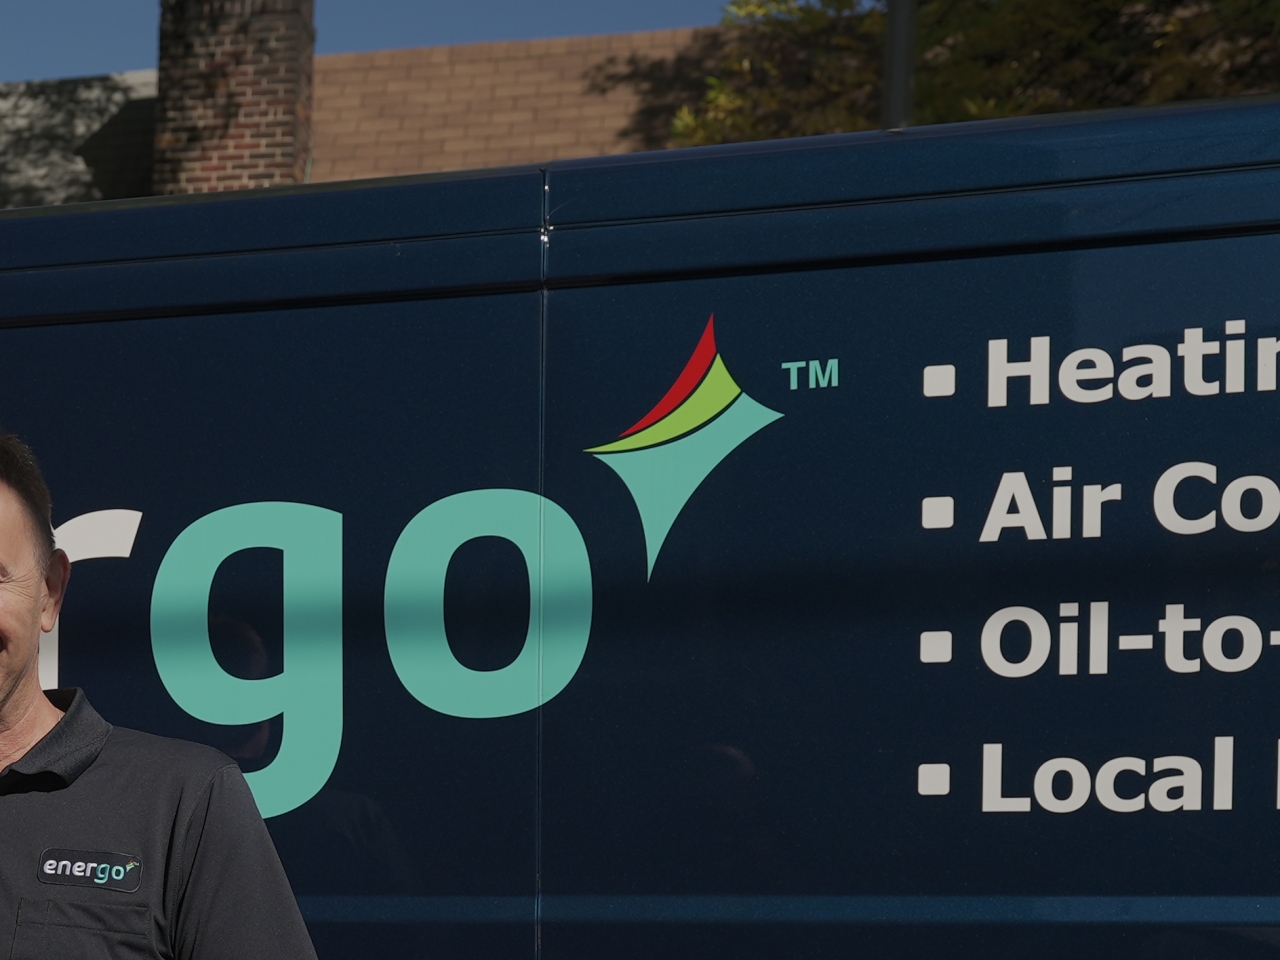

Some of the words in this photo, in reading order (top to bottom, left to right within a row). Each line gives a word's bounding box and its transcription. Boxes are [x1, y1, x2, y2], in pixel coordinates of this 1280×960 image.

[780, 358, 840, 391] TM
[978, 466, 1122, 543] Air
[1153, 461, 1280, 535] Co
[982, 736, 1234, 813] Local
[42, 859, 125, 884] energo
